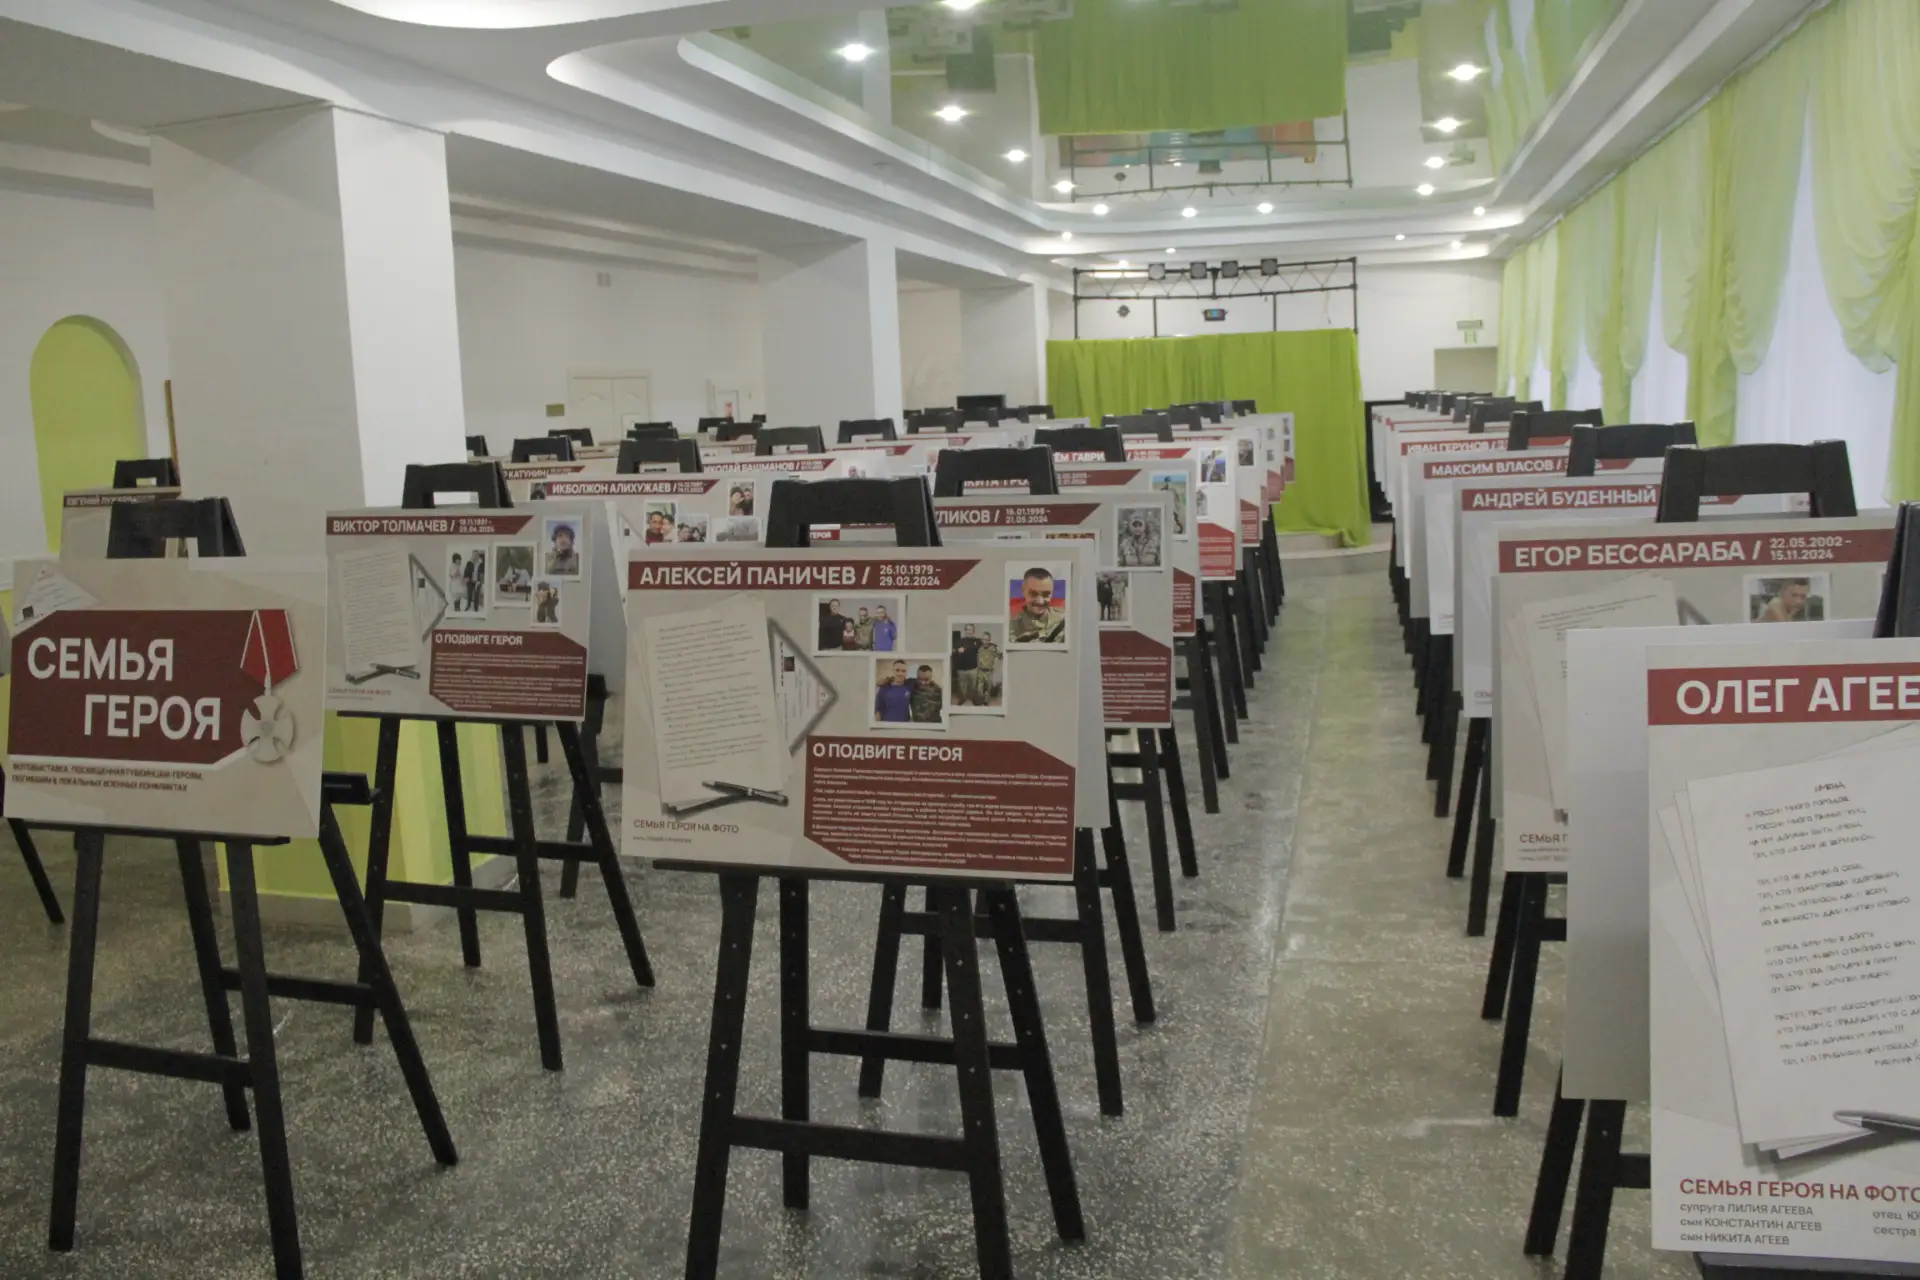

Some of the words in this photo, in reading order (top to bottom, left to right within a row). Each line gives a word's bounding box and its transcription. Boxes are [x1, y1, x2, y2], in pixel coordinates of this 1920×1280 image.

[1072, 451, 1105, 461] ГАВРИ
[1431, 463, 1494, 477] МАКСИМ
[1496, 459, 1552, 474] ВЛАСОВ
[552, 481, 609, 495] ИКБОЛЖОН
[610, 480, 670, 494] АЛИХУЖАЕВ
[1472, 486, 1549, 509] АНДРЕЙ
[1551, 484, 1657, 507] БУДЕННЫЙ
[333, 519, 379, 533] ВИКТОР
[381, 519, 448, 533] ТОЛМАЧЕВ
[1769, 536, 1842, 550] 22.05.2002
[1515, 545, 1582, 568] ЕГОР
[1587, 540, 1745, 565] БЕССАРАБА
[1770, 548, 1834, 561] 15.11.2024
[639, 562, 742, 586] АЛЕКСЕЙ
[747, 565, 856, 586] ПАНИЧЕВ
[879, 564, 934, 575] 26.10.1979
[879, 575, 941, 587] 29.02.2024
[444, 634, 490, 645] ПОДВИГЕ
[491, 635, 523, 646] ГЕРОЯ
[27, 636, 174, 682] СЕМЬЯ
[1676, 678, 1800, 715] ОЛЕГ
[1807, 675, 1920, 712] АГЕЕ
[83, 693, 221, 741] ГЕРОЯ
[812, 742, 826, 758] О
[829, 743, 906, 761] ПОДВИГЕ
[909, 746, 963, 761] ГЕРОЯ
[633, 819, 665, 829] СЕМЬЯ
[667, 821, 696, 832] ГЕРОЯ
[698, 823, 711, 832] НА
[712, 824, 739, 833] ФОТО
[1519, 833, 1560, 844] СЕМЬЯ
[1680, 1178, 1752, 1196] СЕМЬЯ
[1757, 1180, 1824, 1199] ГЕРОЯ
[1829, 1183, 1860, 1200] НА
[1864, 1185, 1920, 1203] ФОТО
[1680, 1204, 1725, 1215] супруга
[1727, 1204, 1769, 1215] ЛИЛИЯ
[1770, 1206, 1814, 1216] АГЕЕВА
[1872, 1211, 1903, 1221] отец
[1680, 1219, 1703, 1227] сын
[1704, 1218, 1784, 1230] КОНСТАНТИН
[1786, 1221, 1823, 1232] АГЕЕВ
[1873, 1227, 1917, 1238] сестра
[1680, 1234, 1703, 1242] сын
[1704, 1234, 1752, 1245] НИКИТА
[1754, 1236, 1790, 1246] АГЕЕВ
